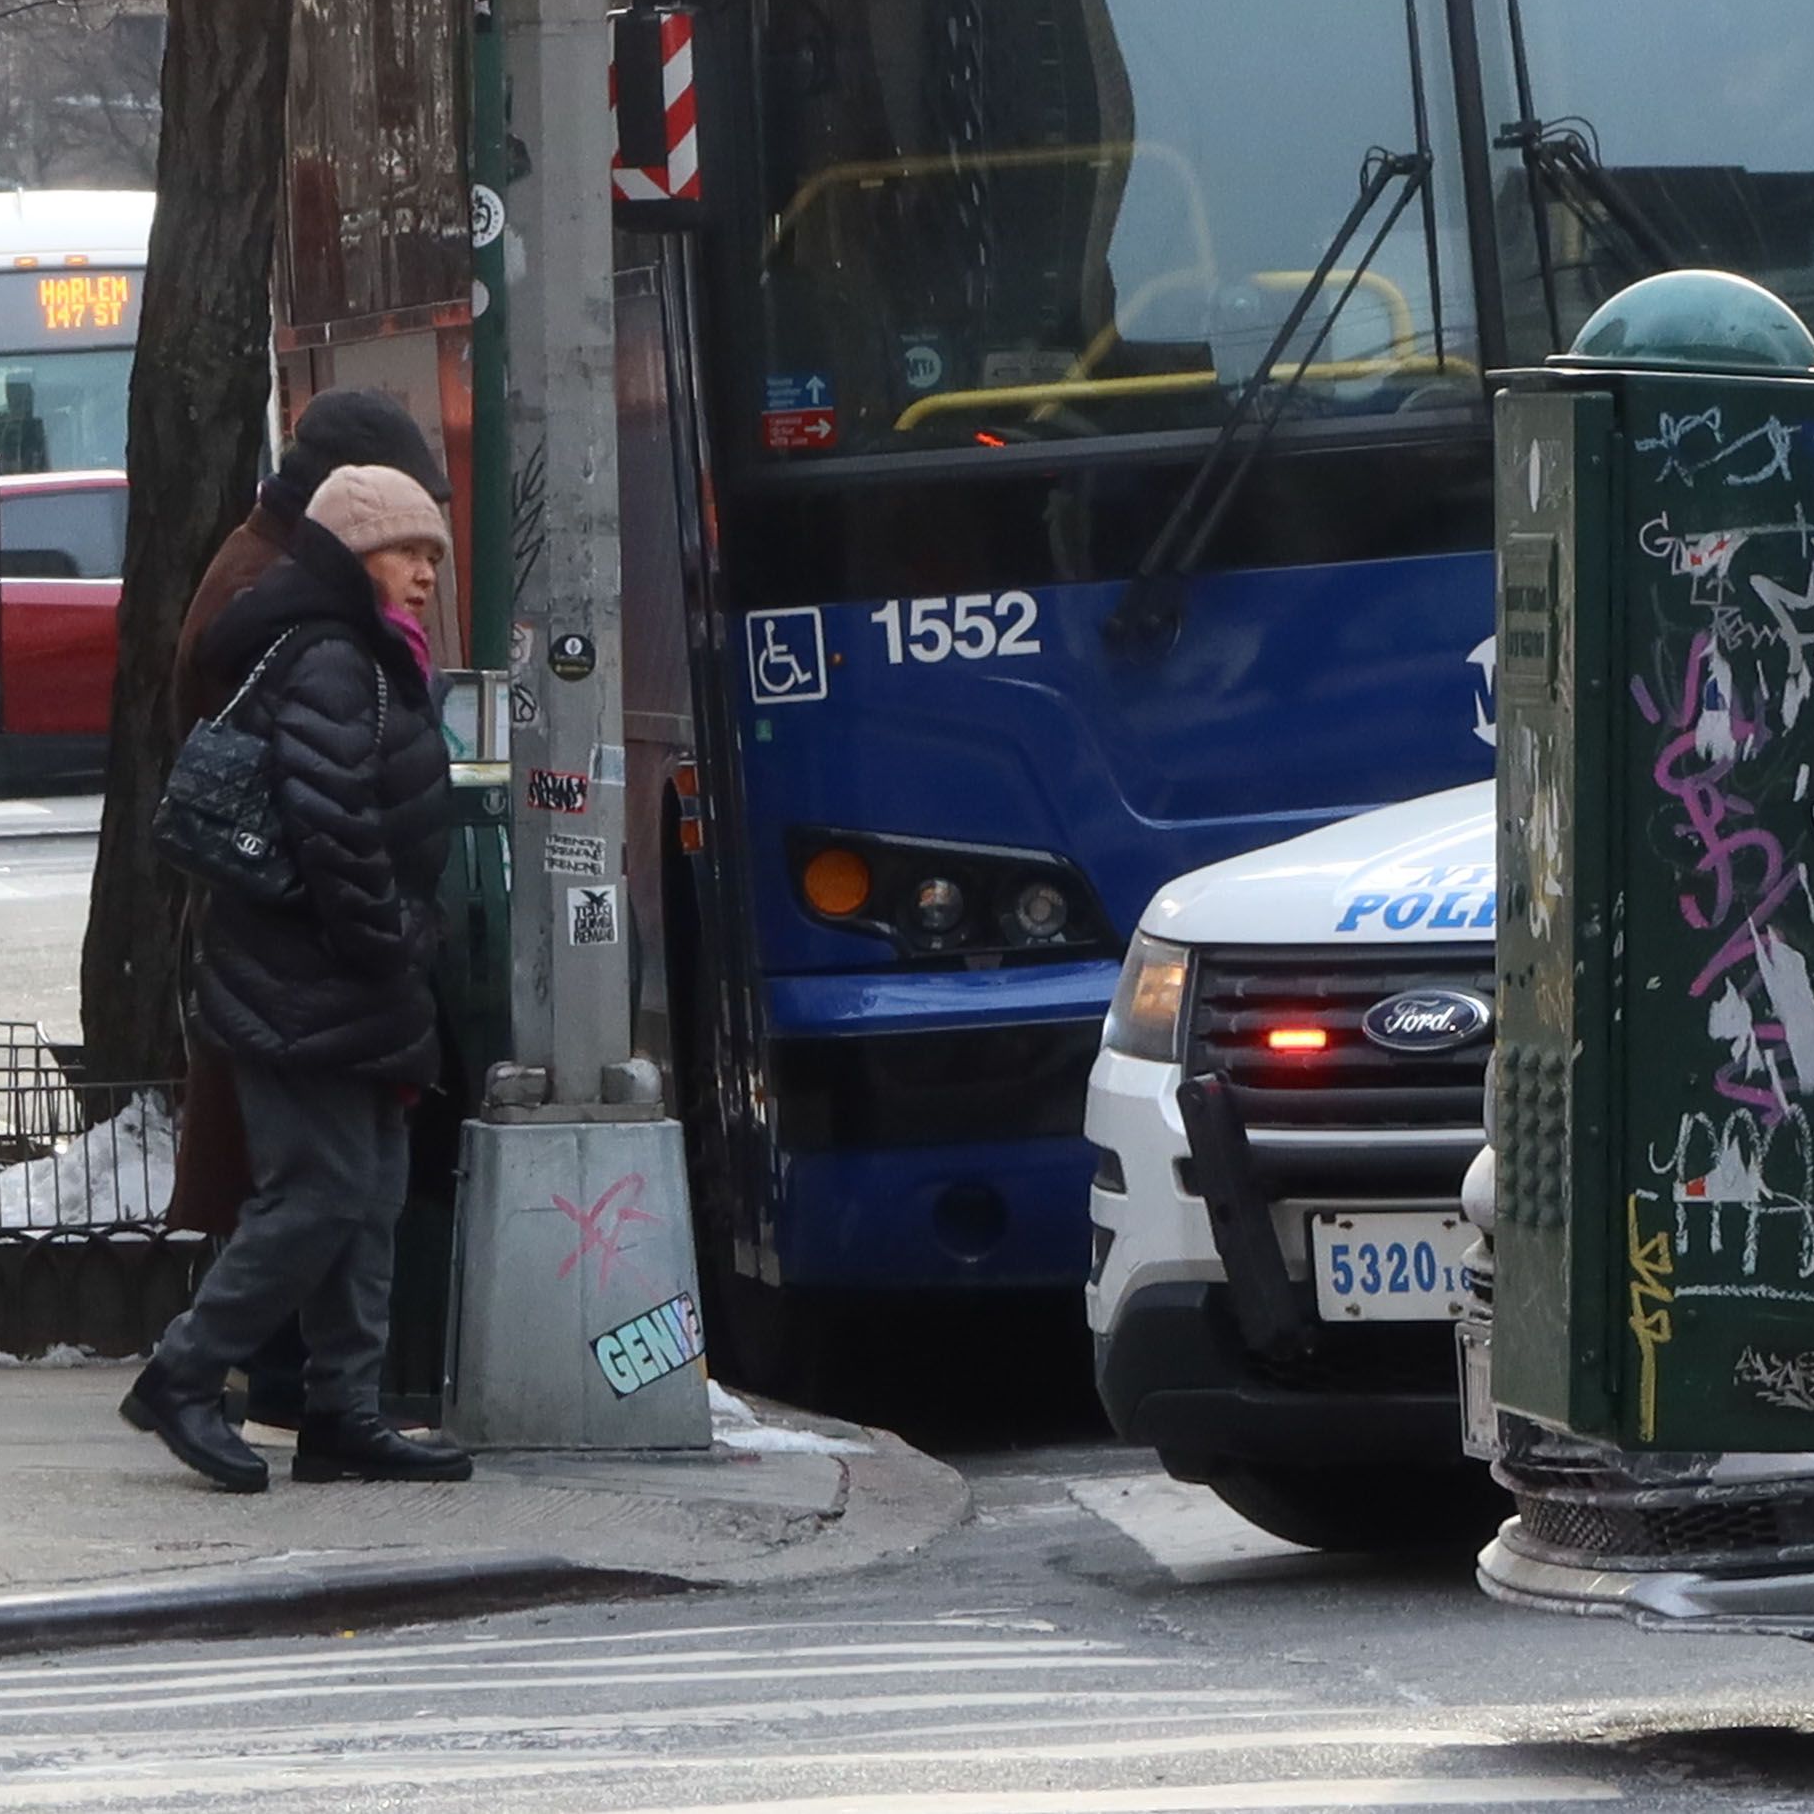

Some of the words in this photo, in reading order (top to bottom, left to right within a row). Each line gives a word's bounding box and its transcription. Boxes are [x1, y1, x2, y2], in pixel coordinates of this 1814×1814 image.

[39, 275, 128, 307] HARLEM
[45, 304, 84, 330] 147
[93, 302, 123, 326] ST
[871, 590, 1041, 665] 1552
[1385, 999, 1451, 1033] Ford
[1331, 1241, 1436, 1295] 5320
